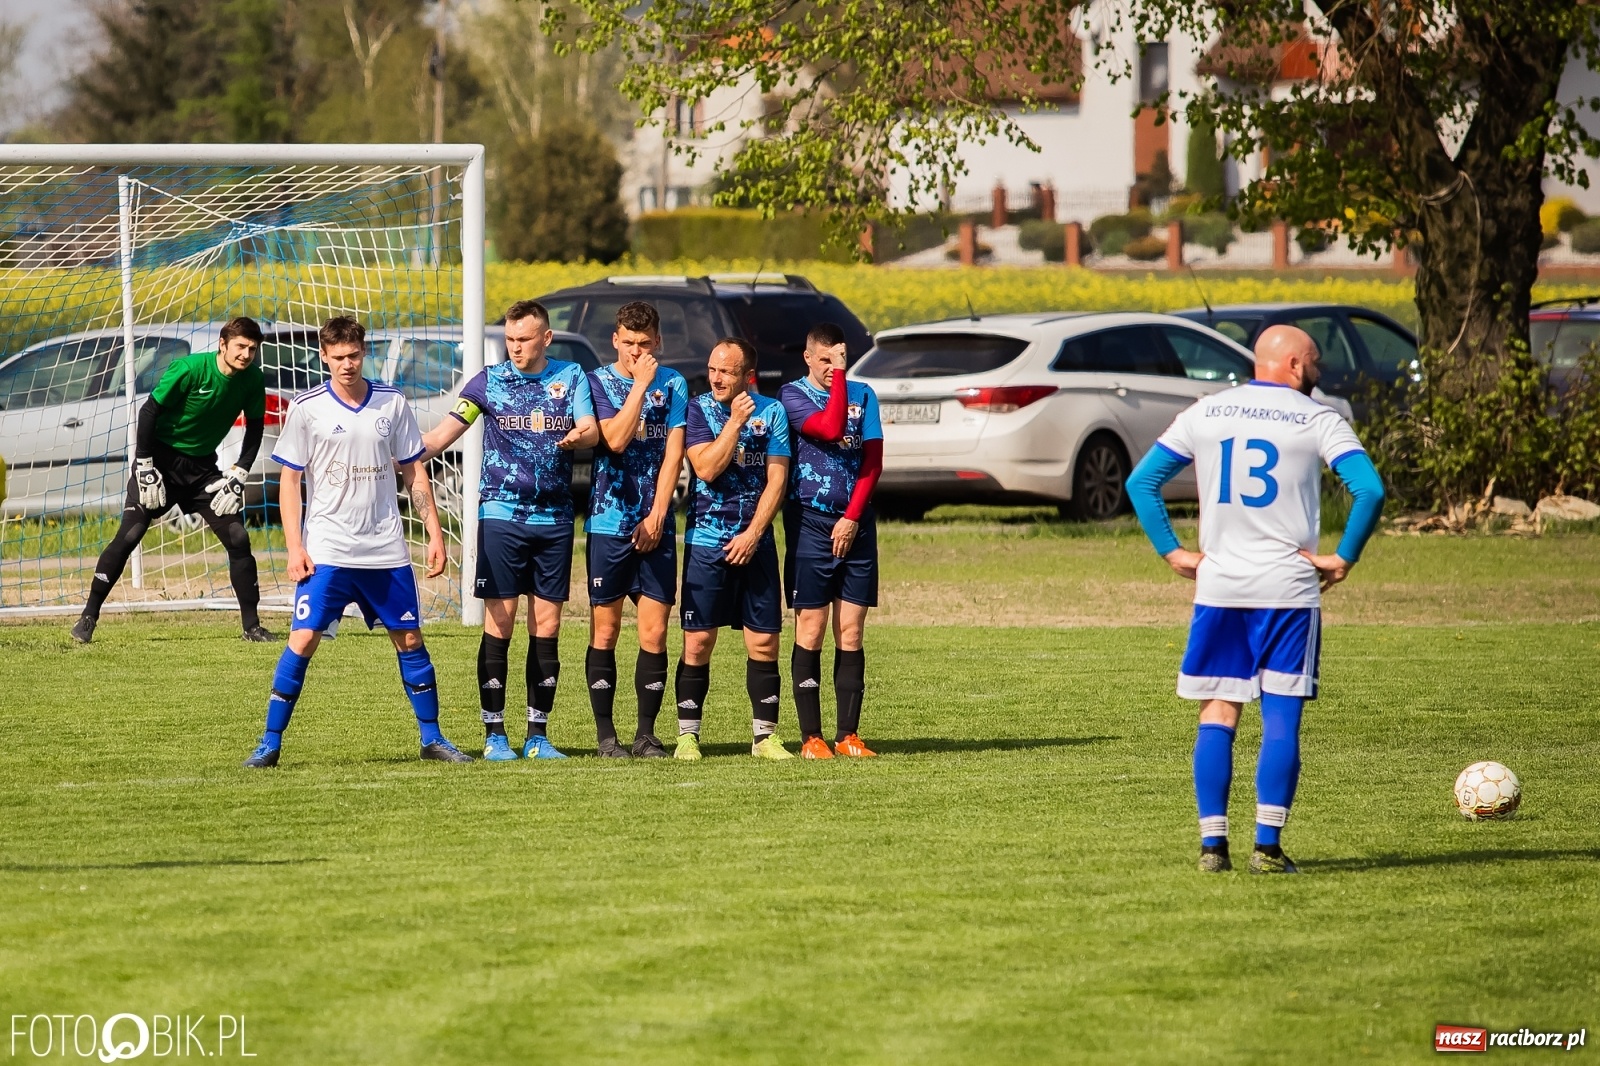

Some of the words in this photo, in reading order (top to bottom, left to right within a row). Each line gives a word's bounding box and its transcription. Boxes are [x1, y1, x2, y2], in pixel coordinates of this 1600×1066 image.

[456, 400, 469, 414] C
[1205, 405, 1222, 418] LKS
[1223, 405, 1239, 418] 07
[1239, 406, 1309, 425] MARKOWICE
[1217, 436, 1280, 509] 13
[296, 595, 311, 621] 6
